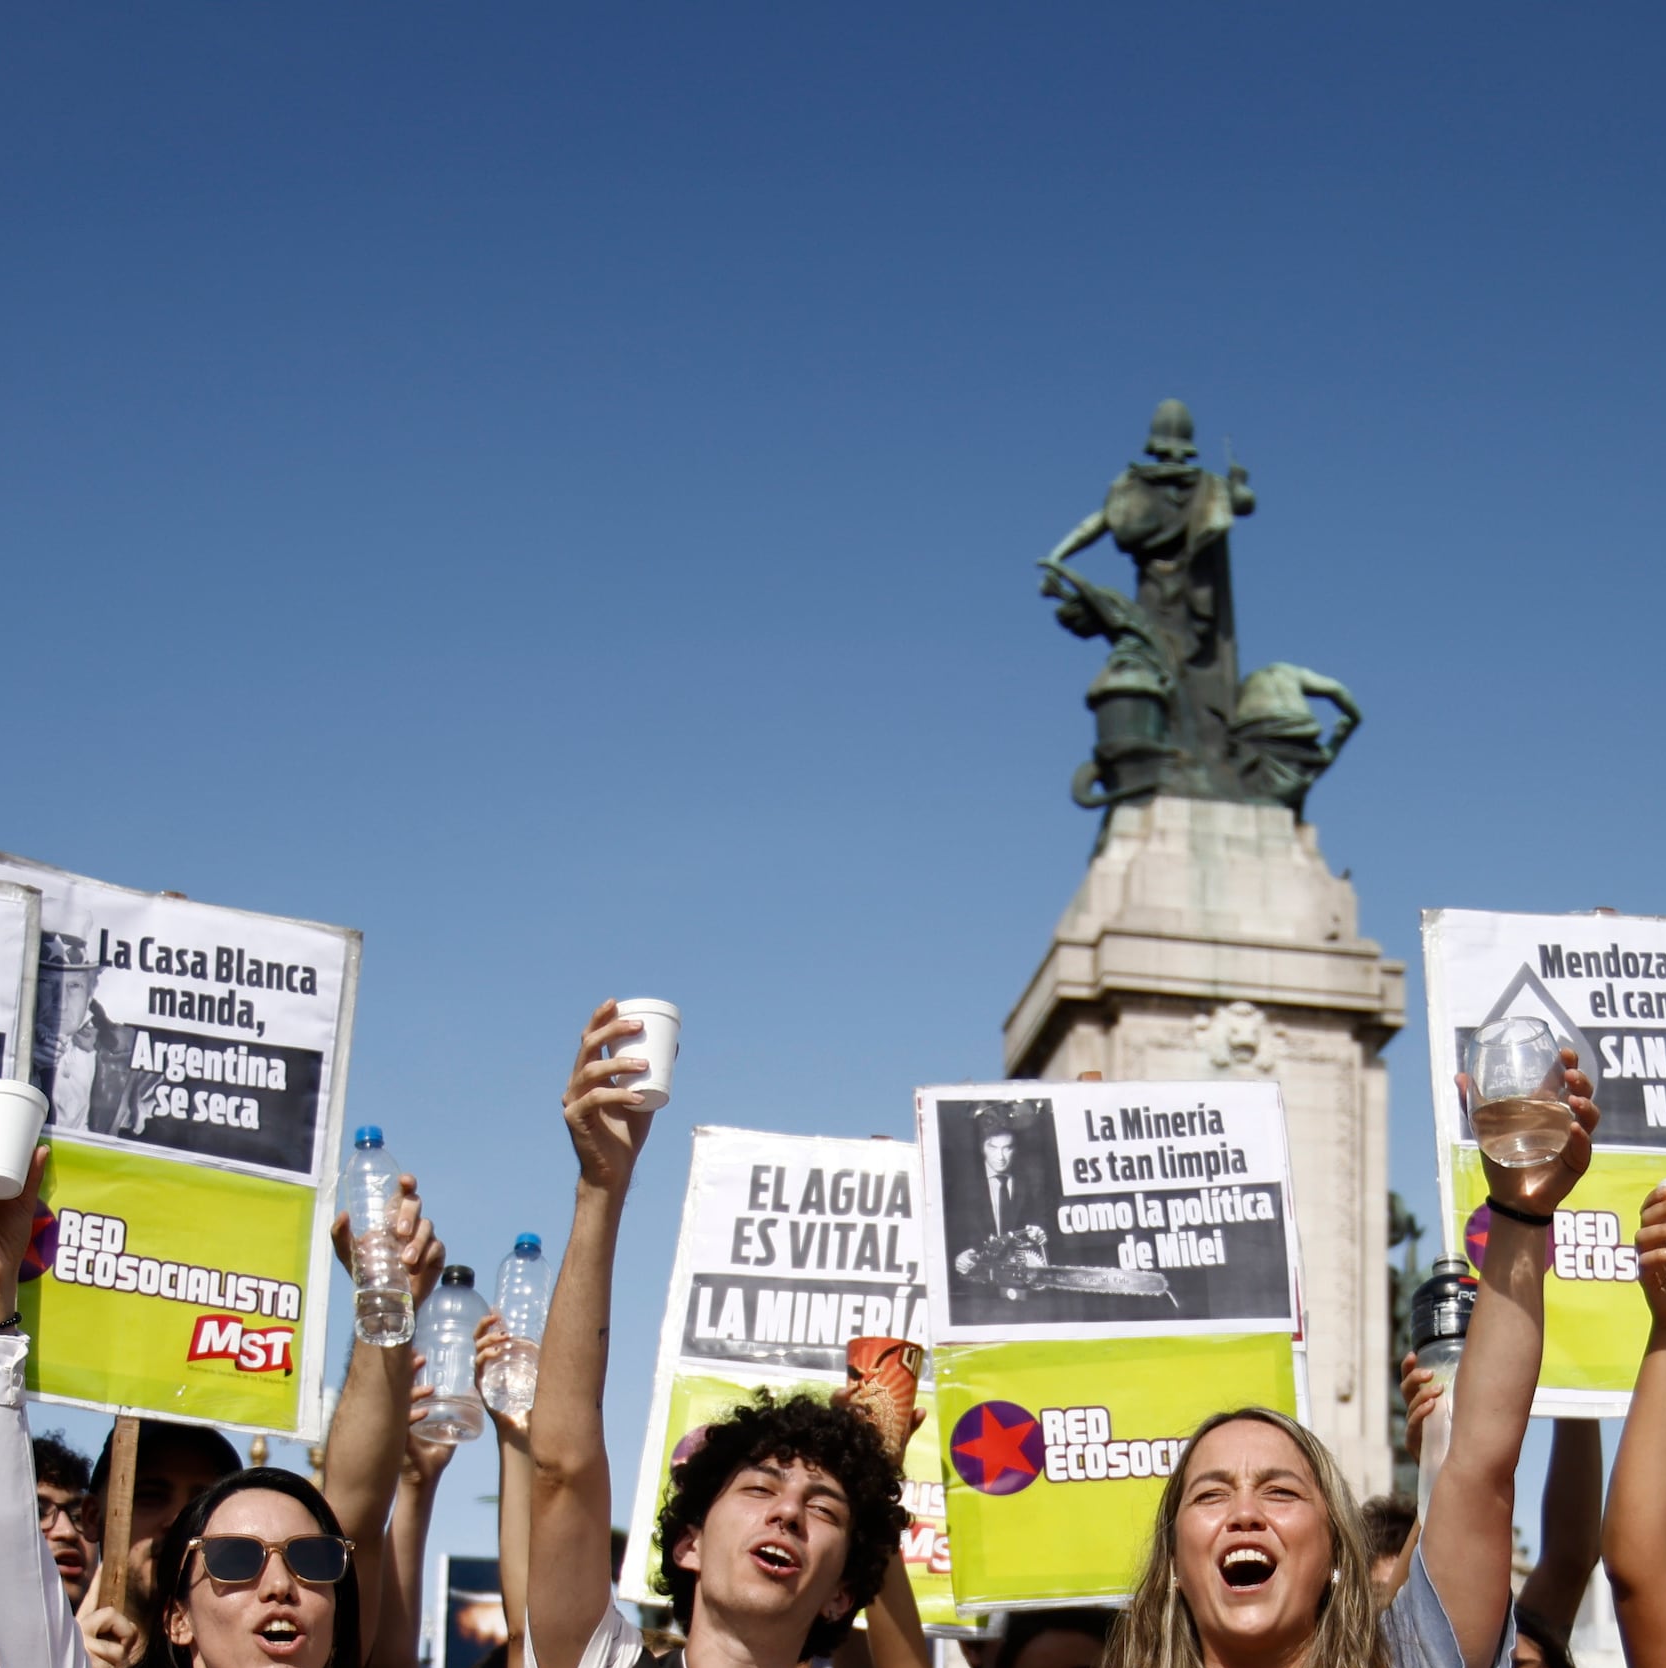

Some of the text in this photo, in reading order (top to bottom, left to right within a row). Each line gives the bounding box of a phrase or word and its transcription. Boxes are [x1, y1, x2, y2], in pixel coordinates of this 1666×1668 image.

[99, 928, 318, 996] La Casa Blanca
[148, 986, 266, 1038] manda,
[1590, 983, 1619, 1019] el
[131, 1031, 287, 1091] Argentina
[154, 1085, 259, 1130] se seca
[1085, 1102, 1225, 1143] La Minería
[1073, 1145, 1248, 1184] es tan limpia
[748, 1165, 912, 1219] EL AGUA
[1057, 1188, 1275, 1235] como la política
[58, 1208, 125, 1255] RED
[731, 1217, 919, 1284] ES VITAL,
[1118, 1229, 1226, 1270] de Milei
[1553, 1210, 1620, 1247] RED
[54, 1246, 301, 1321] ECOSOCIALISTA
[694, 1287, 745, 1340] LA
[197, 1321, 293, 1369] MST
[1040, 1406, 1110, 1446] RED
